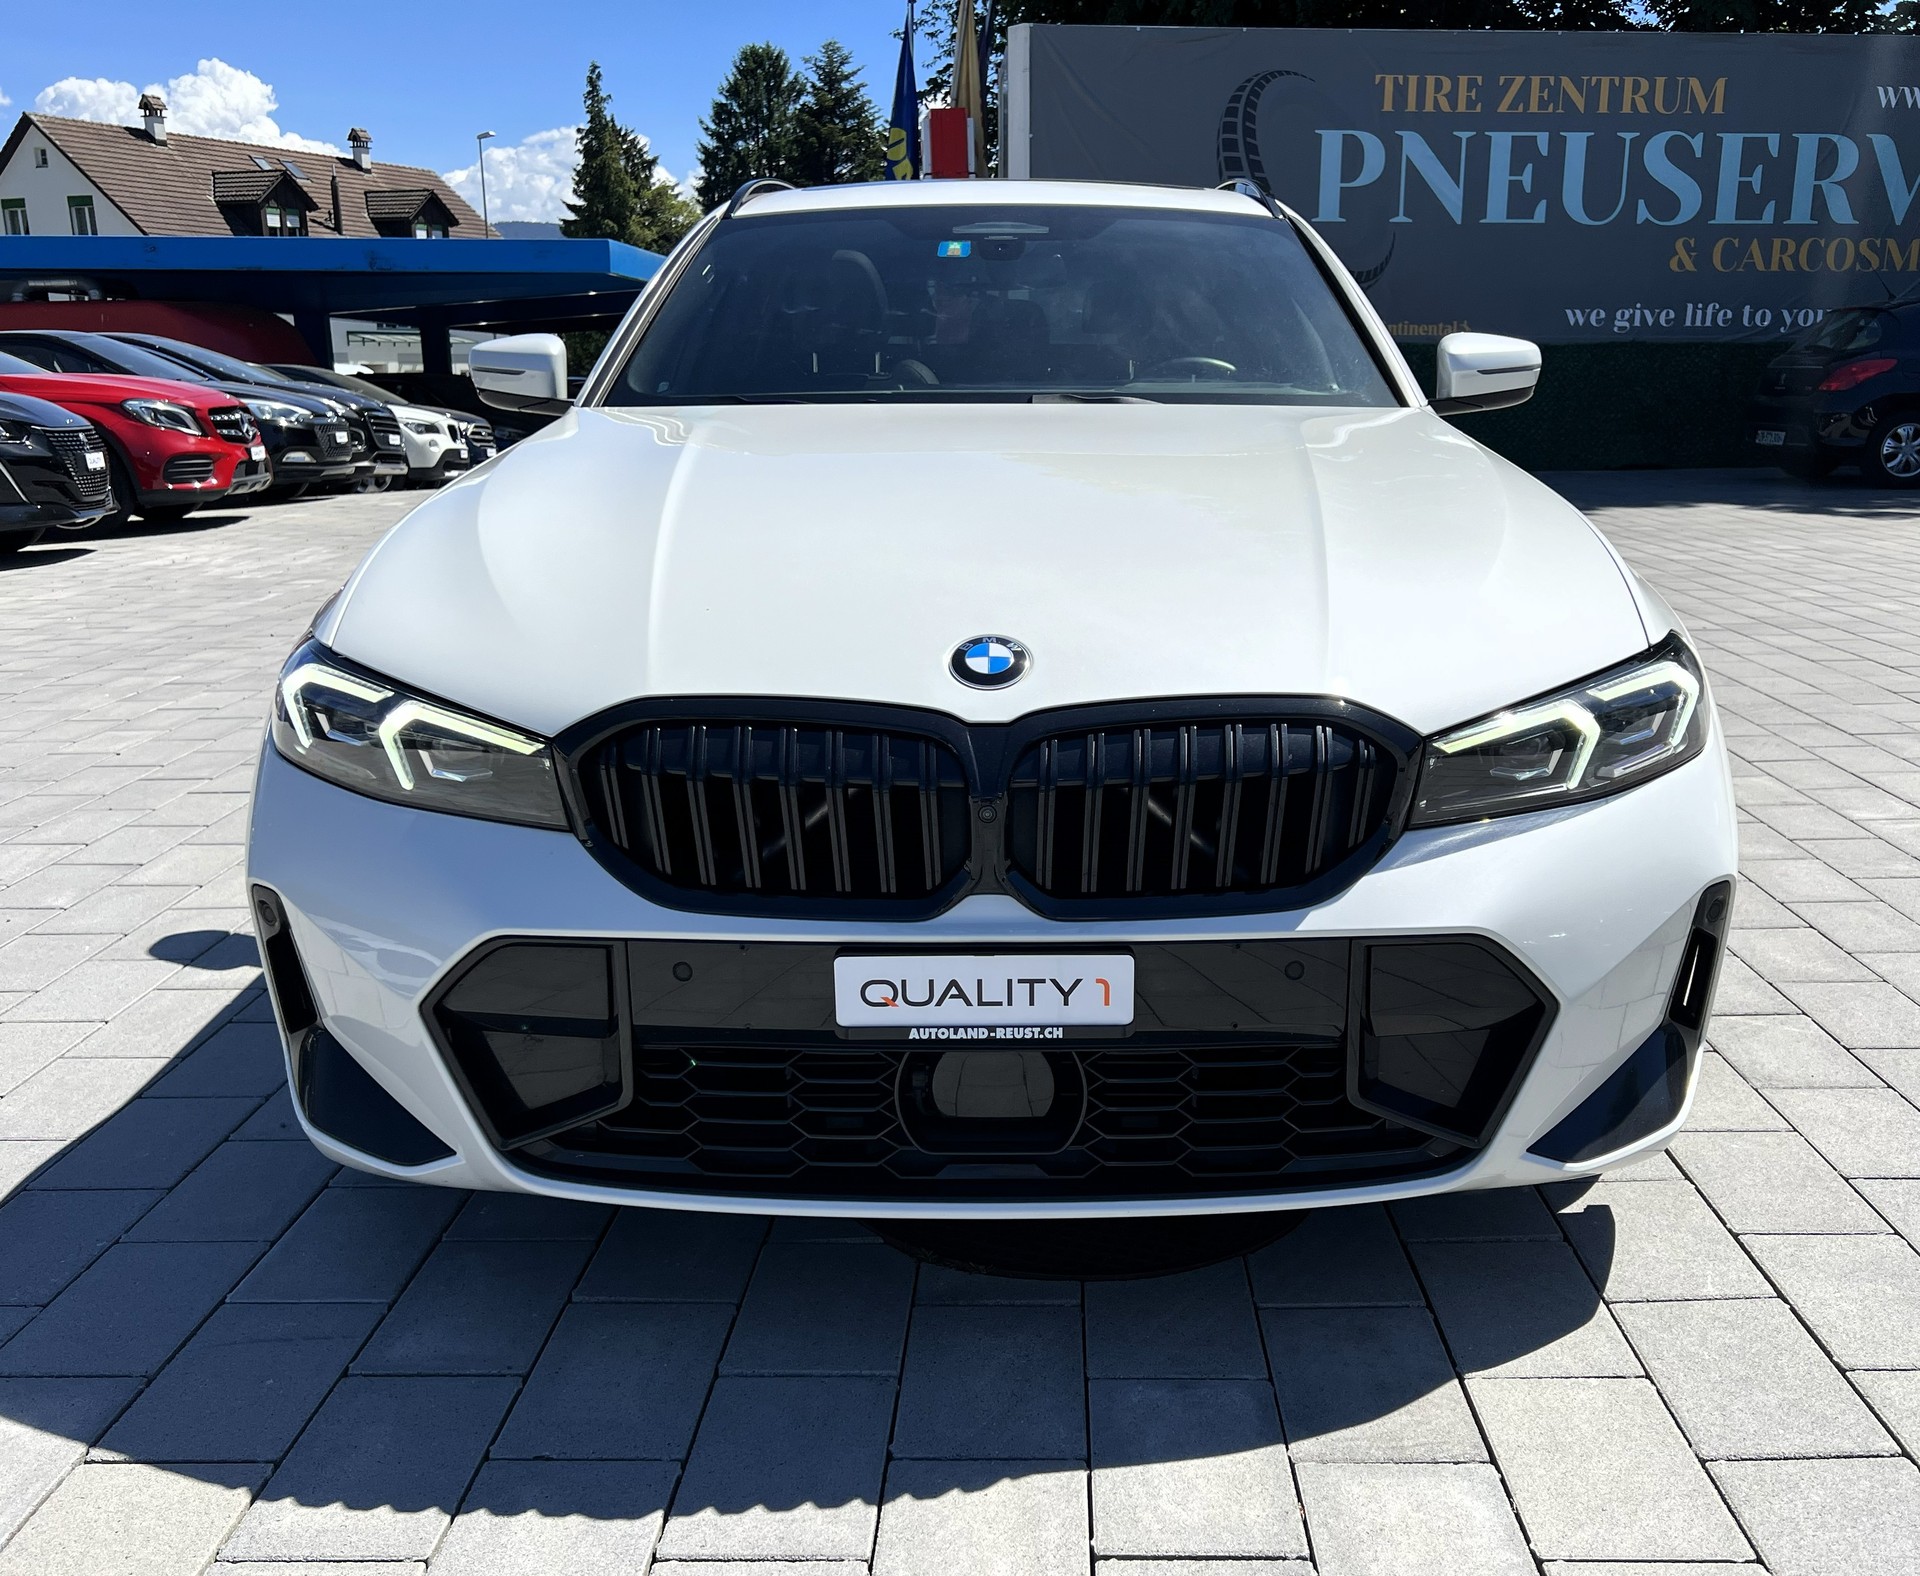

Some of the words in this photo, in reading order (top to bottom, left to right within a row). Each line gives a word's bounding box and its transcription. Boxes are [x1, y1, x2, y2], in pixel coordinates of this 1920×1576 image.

[1374, 74, 1482, 113] TIRE
[1497, 76, 1728, 115] ZENTRUM
[1310, 129, 1920, 226] PNEUSERV
[1669, 237, 1697, 272] &
[1712, 236, 1920, 273] CARCOSM
[1388, 320, 1457, 336] ntinental
[1565, 307, 1605, 327] we
[1613, 303, 1675, 334] give
[1683, 303, 1733, 328] life
[1742, 304, 1772, 328] to
[959, 637, 1022, 651] BMW
[860, 978, 1083, 1007] QUALITY
[1095, 978, 1110, 1006] 1
[909, 1027, 1063, 1039] AUTOLAND-REUST.CH
